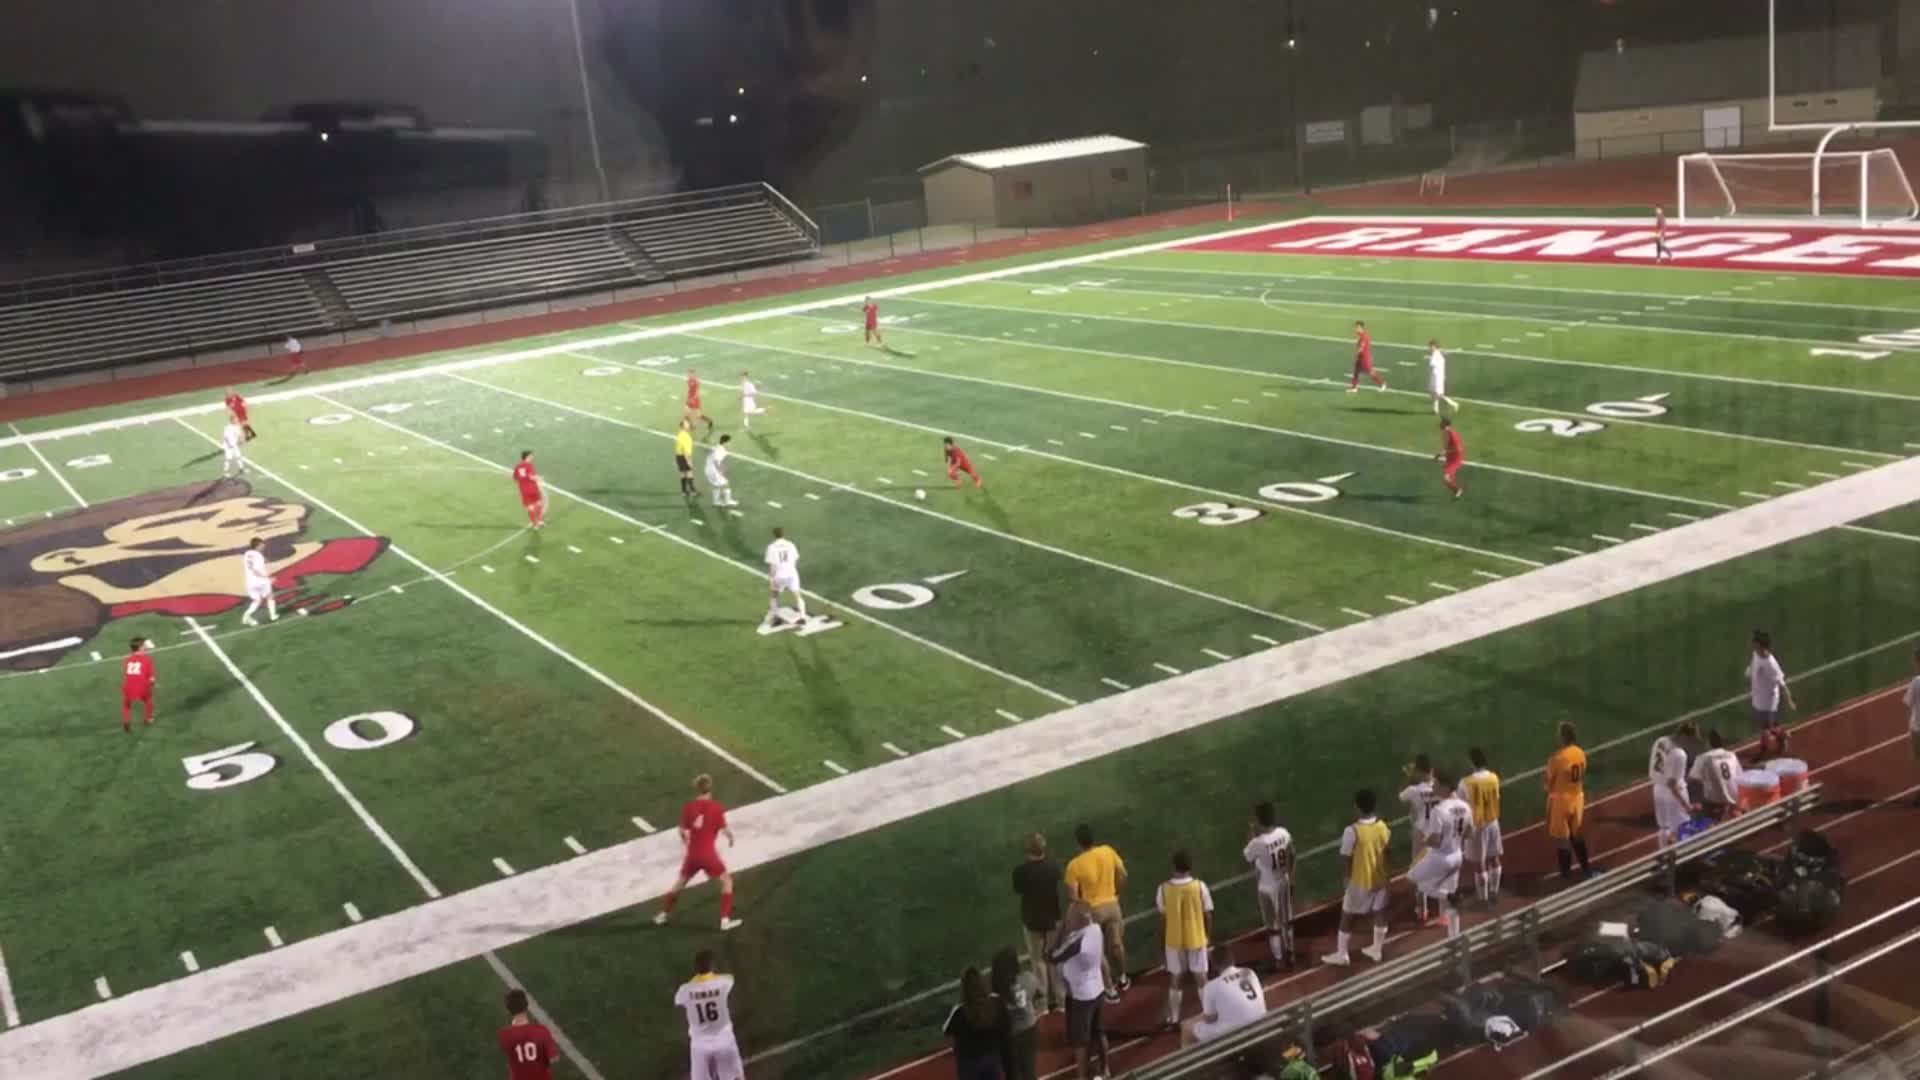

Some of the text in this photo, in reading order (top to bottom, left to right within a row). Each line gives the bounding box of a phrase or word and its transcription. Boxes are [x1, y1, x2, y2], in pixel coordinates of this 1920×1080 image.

[1513, 401, 1668, 437] 20
[1171, 482, 1341, 526] 30
[127, 661, 142, 675] 22
[181, 711, 415, 790] 50
[1239, 980, 1257, 1000] 9
[696, 1001, 719, 1024] 16
[515, 1041, 537, 1063] 10
